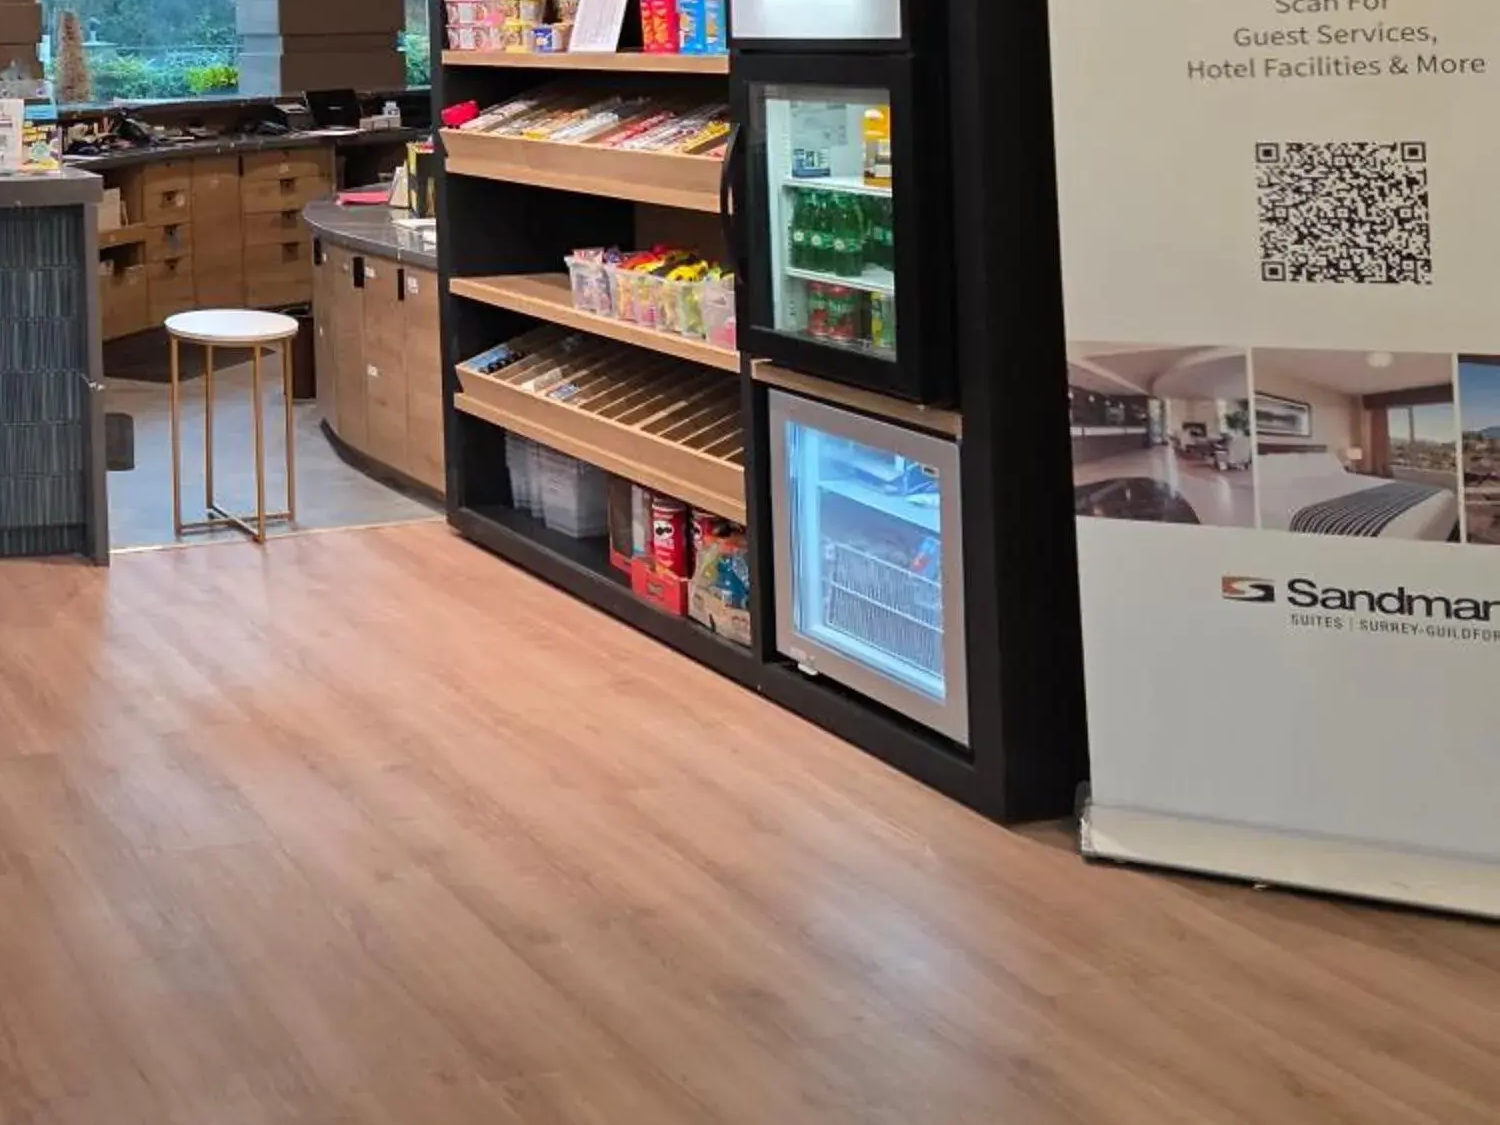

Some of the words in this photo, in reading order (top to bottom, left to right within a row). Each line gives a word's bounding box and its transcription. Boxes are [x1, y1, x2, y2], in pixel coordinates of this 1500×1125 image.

[1233, 25, 1309, 47] Guest
[1317, 22, 1438, 45] Services,
[1187, 57, 1256, 80] Hotel
[1264, 54, 1381, 78] Facilities
[1388, 55, 1409, 76] &
[1416, 53, 1487, 75] More
[1291, 614, 1344, 631] SUITES
